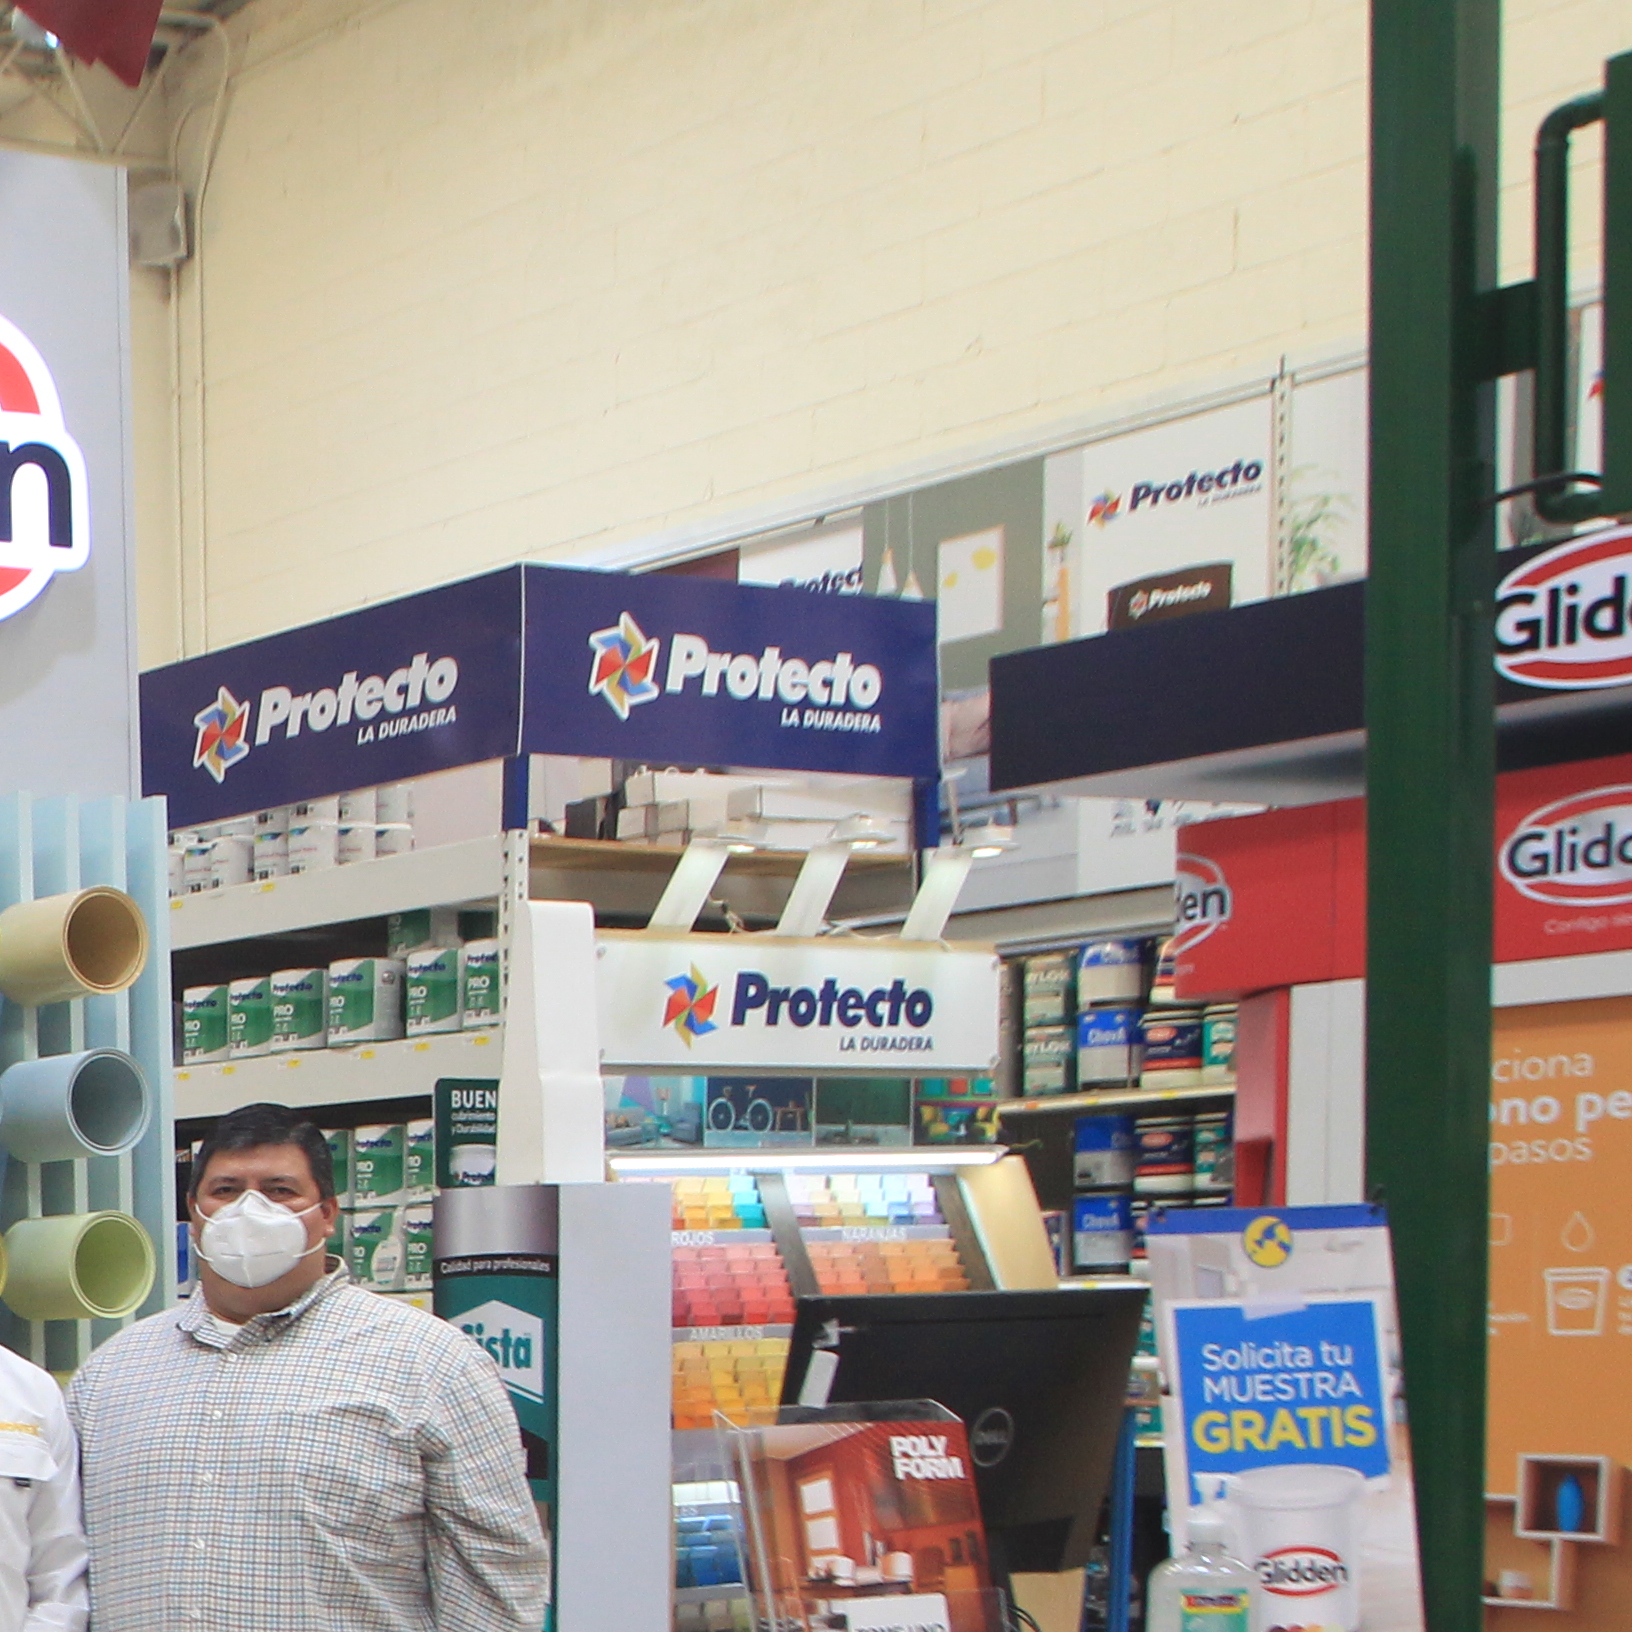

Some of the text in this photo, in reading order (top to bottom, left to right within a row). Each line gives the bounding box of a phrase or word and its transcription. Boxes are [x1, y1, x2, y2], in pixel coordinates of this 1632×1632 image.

[1128, 459, 1264, 512] Protecto
[1496, 574, 1632, 657] Glid
[665, 633, 882, 711] Protecto
[255, 652, 458, 746] Protecto
[357, 704, 457, 745] LA DURADERA
[780, 707, 882, 733] LA DURADERA
[732, 971, 934, 1030] Protecto
[839, 1036, 934, 1051] LA DURADERA
[1490, 1094, 1561, 1125] no
[1489, 1136, 1594, 1165] pasos
[671, 1232, 714, 1246] ROJOS
[842, 1227, 908, 1241] NARANJAS
[1203, 1341, 1353, 1371] Solicita tu
[1203, 1371, 1363, 1404] MUESTRA
[1193, 1405, 1376, 1453] GRATIS
[890, 1435, 948, 1458] POLY
[894, 1457, 965, 1481] FORM
[1255, 1557, 1348, 1585] Glidden
